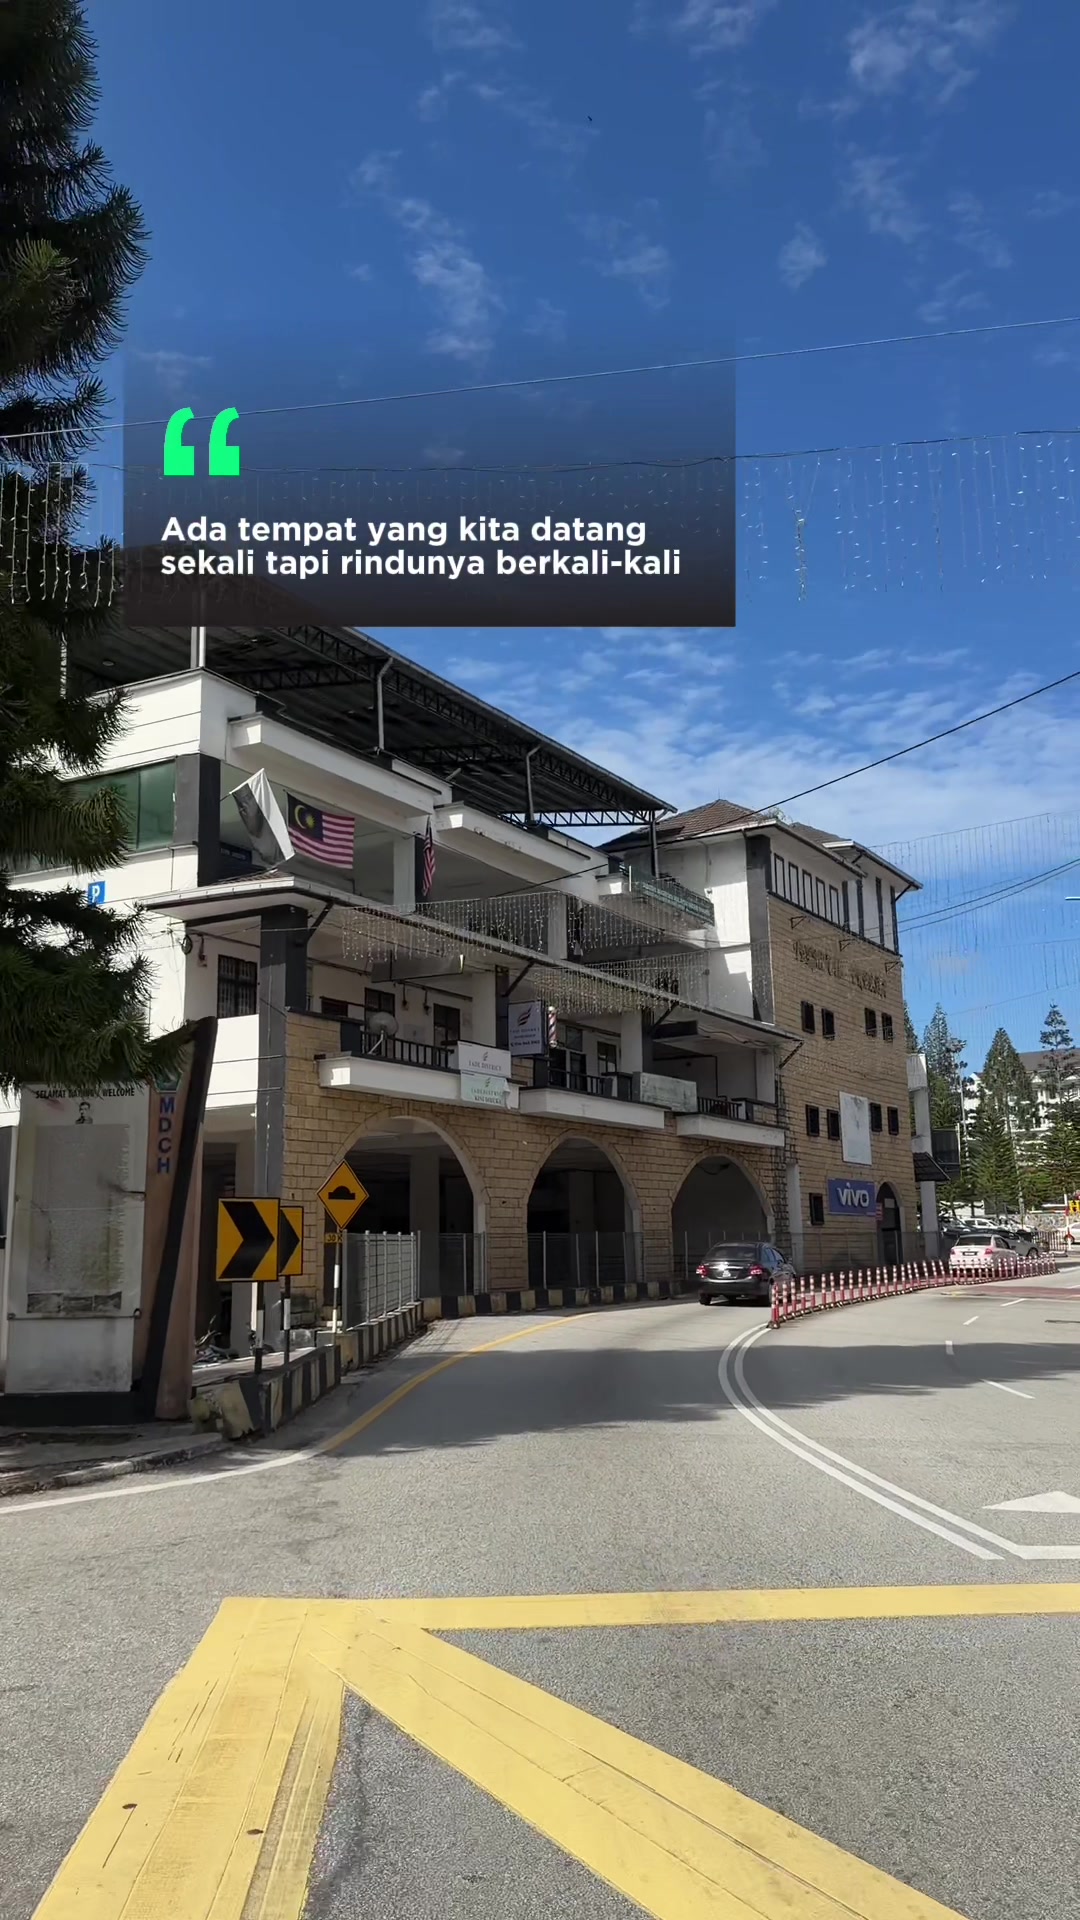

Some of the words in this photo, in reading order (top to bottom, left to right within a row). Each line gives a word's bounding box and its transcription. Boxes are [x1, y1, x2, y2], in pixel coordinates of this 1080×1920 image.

[91, 884, 101, 904] P
[35, 1089, 66, 1099] SELAMAT
[102, 1087, 135, 1097] WELCOME
[157, 1096, 176, 1174] MDCH
[837, 1182, 870, 1208] vivo
